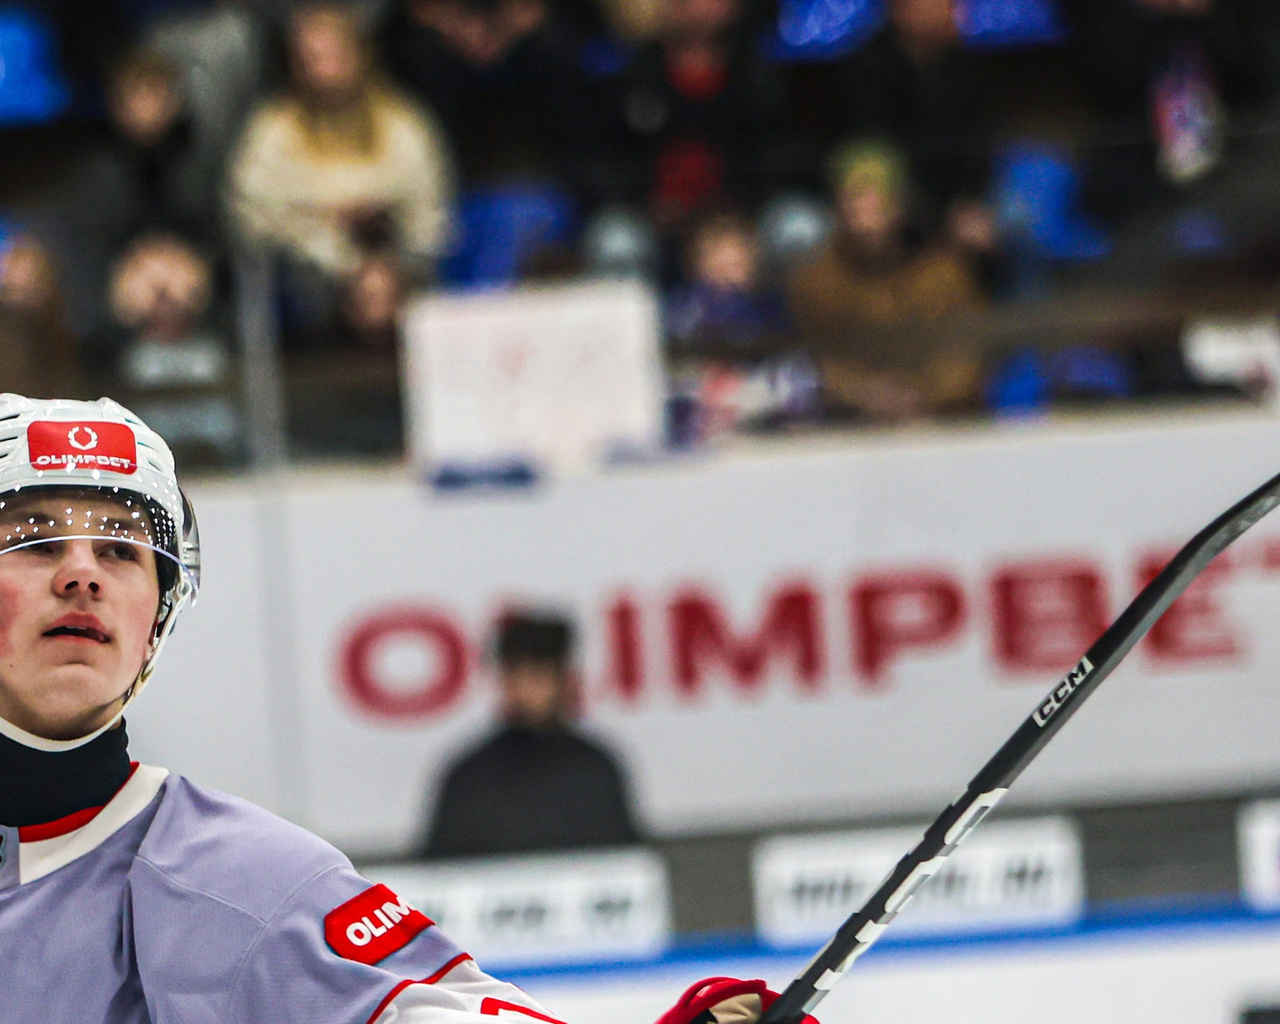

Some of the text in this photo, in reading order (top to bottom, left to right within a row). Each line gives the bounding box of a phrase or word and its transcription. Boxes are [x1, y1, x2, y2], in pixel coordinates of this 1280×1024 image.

[37, 454, 131, 468] OLIMPBET
[332, 536, 1280, 726] OIMPBE
[1035, 656, 1093, 726] CCM
